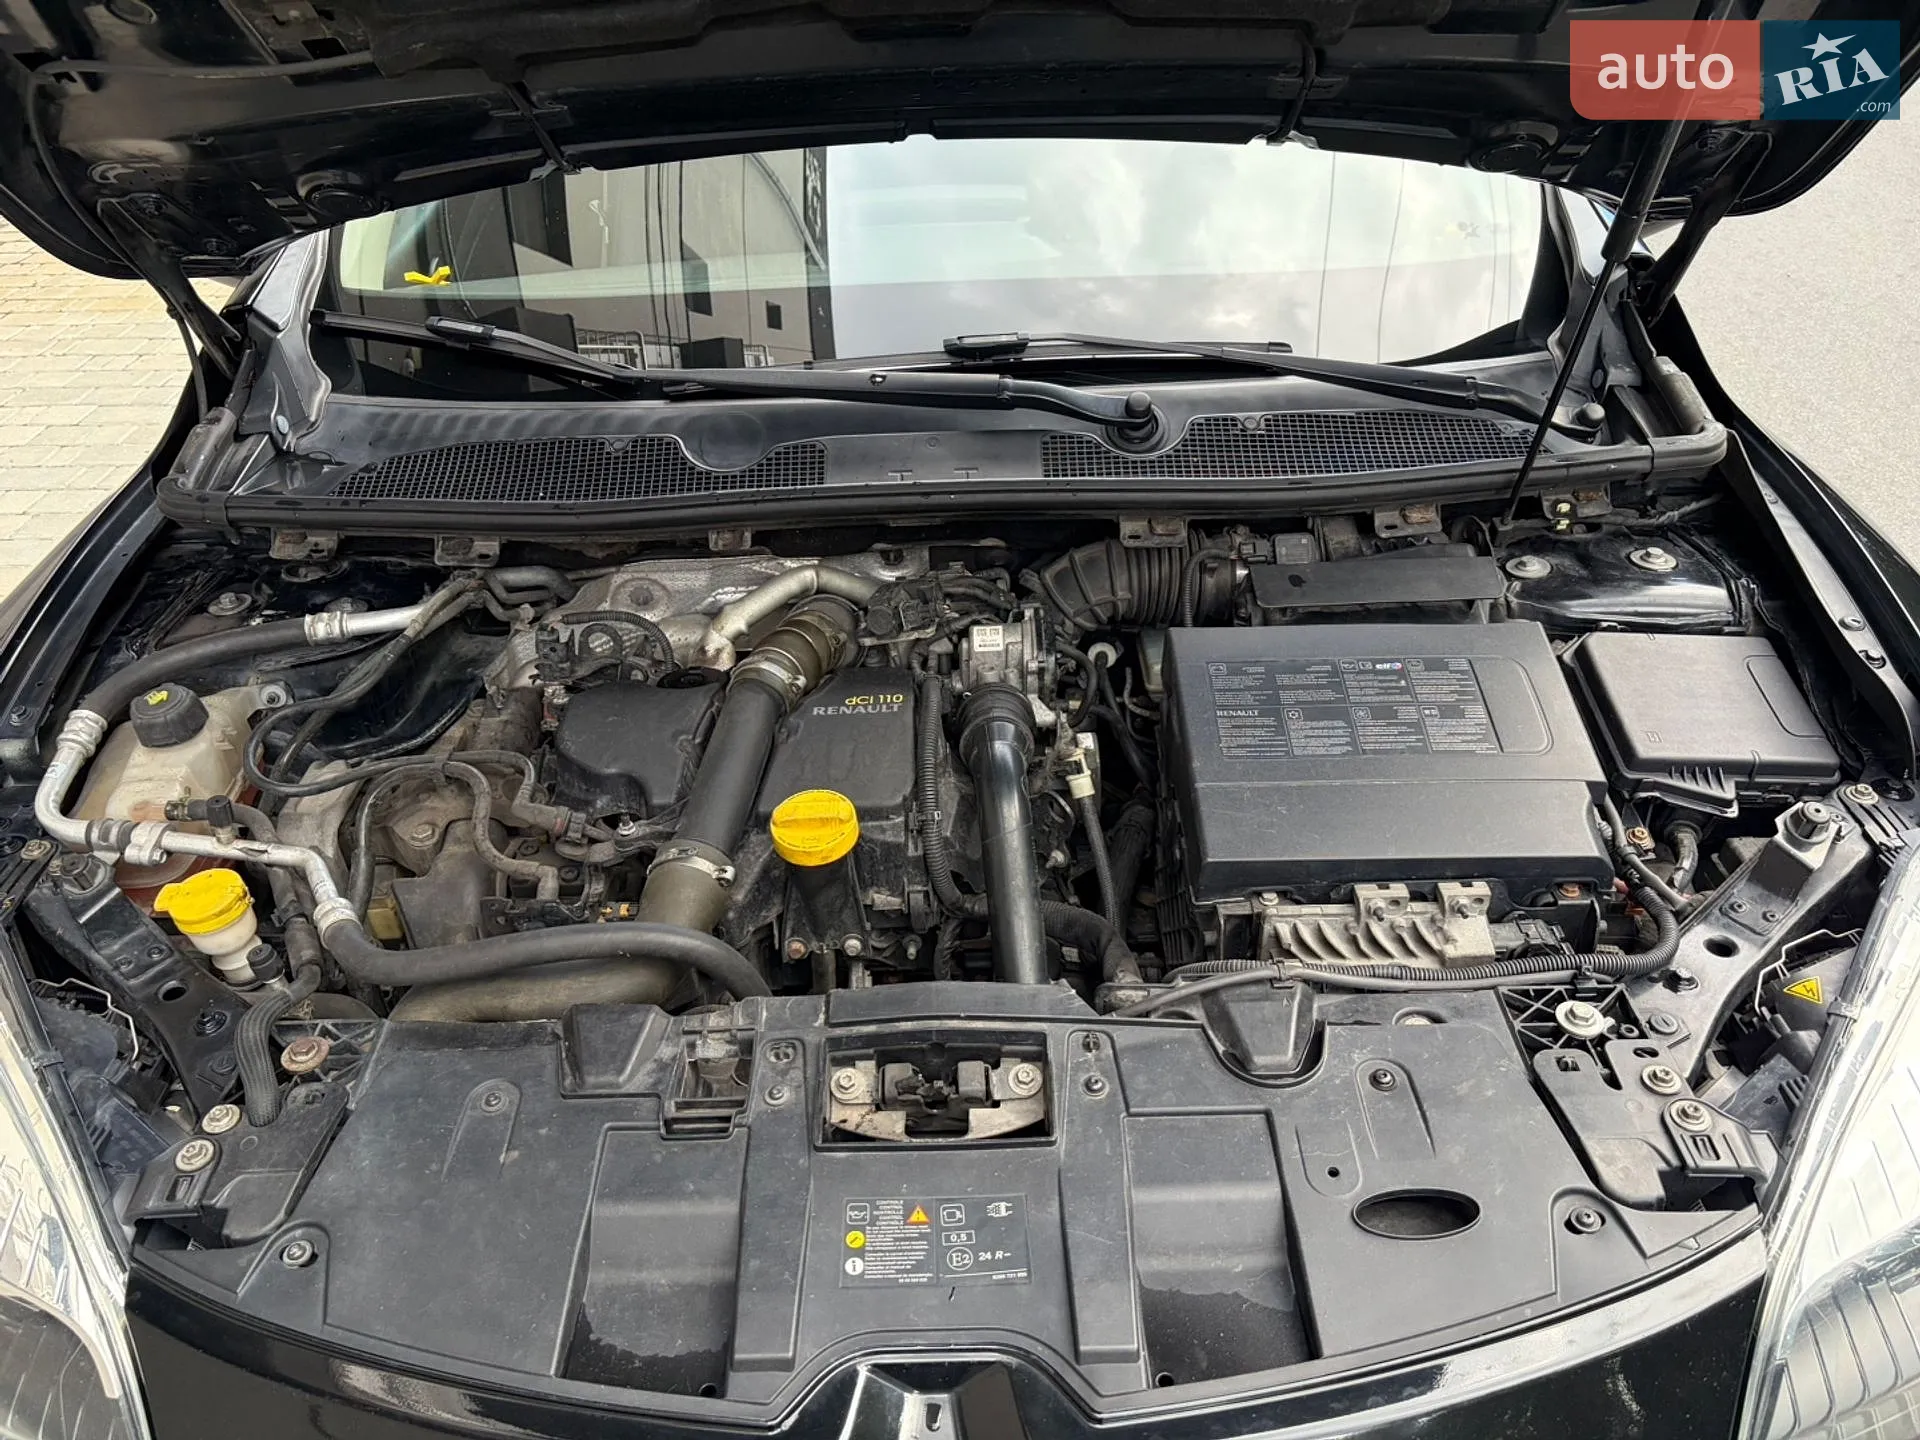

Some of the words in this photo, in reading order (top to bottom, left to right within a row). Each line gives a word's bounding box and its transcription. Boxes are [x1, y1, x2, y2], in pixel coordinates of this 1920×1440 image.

[879, 693, 904, 704] 110
[812, 703, 902, 716] RENAULT
[950, 1233, 967, 1243] 0,5
[951, 1252, 971, 1267] E2
[978, 1252, 992, 1261] 24
